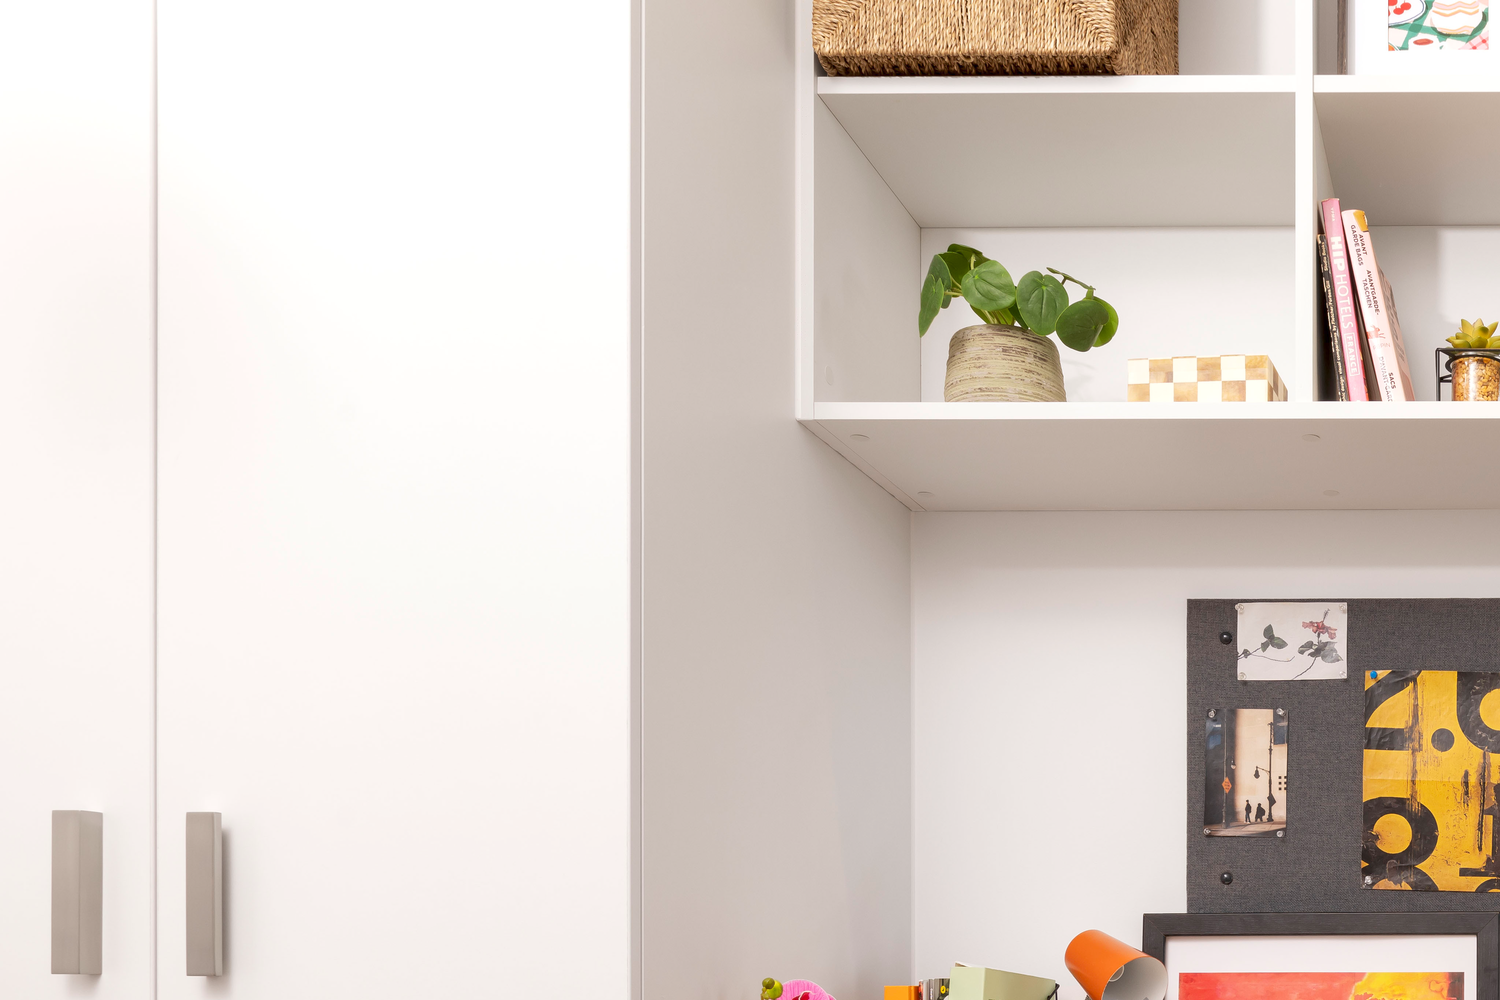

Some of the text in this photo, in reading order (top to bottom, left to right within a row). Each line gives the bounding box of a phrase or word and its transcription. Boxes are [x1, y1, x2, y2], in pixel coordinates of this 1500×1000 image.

[1350, 224, 1364, 266] GARDE BAGS
[1359, 233, 1368, 256] AVANT
[1330, 236, 1359, 374] HIP HOTELS FRANCE
[1363, 279, 1373, 309] TASCHEN
[1366, 269, 1380, 315] AVANTGARDE-
[1388, 372, 1396, 389] SACS
